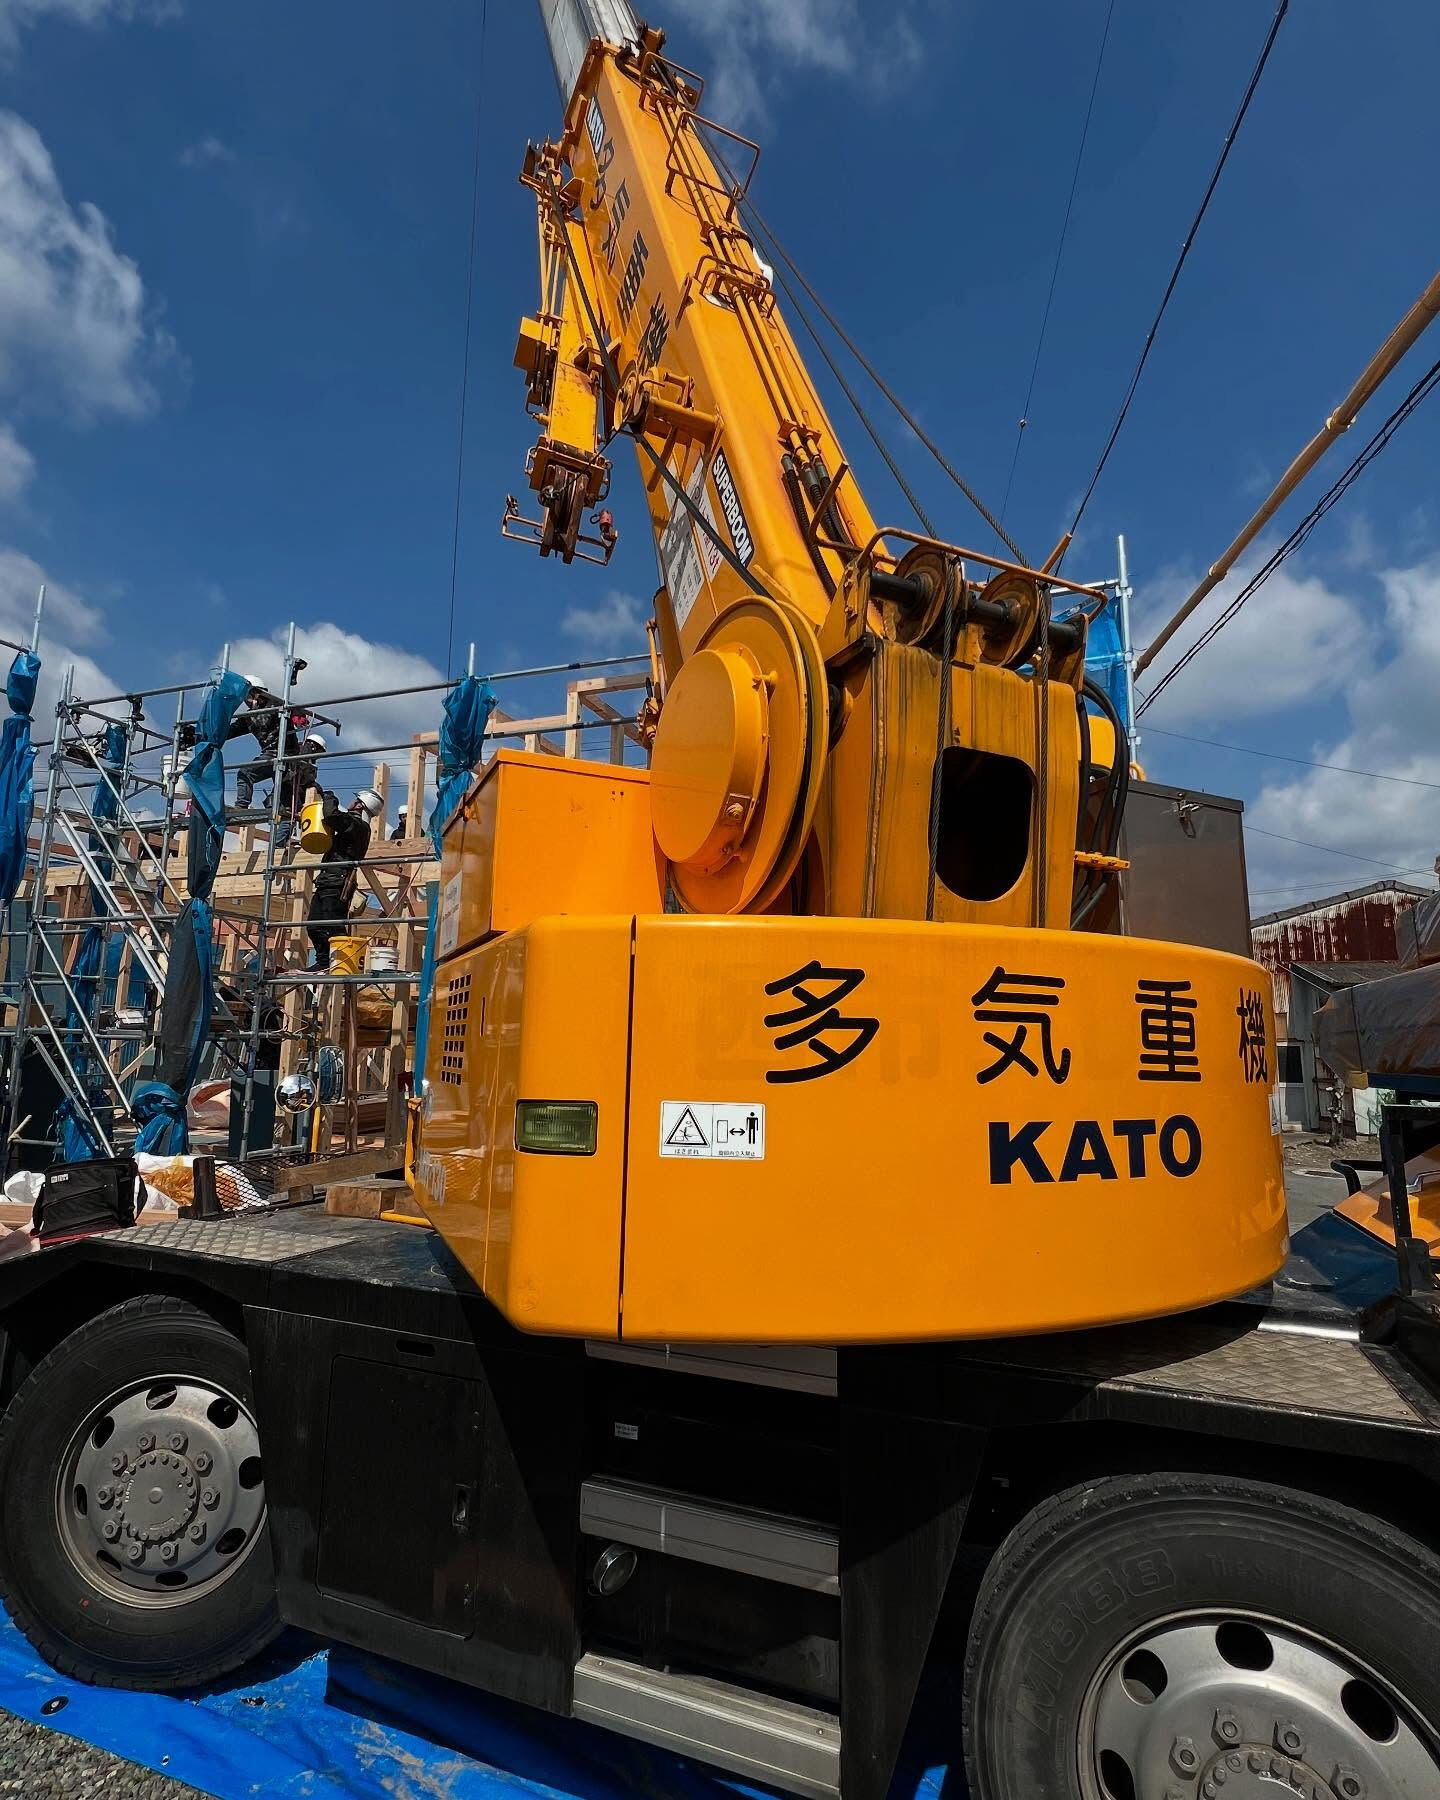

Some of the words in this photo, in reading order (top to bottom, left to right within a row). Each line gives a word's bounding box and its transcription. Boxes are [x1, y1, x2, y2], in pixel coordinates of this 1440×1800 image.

[713, 453, 753, 566] SUPERBOOM
[764, 960, 1268, 1085] 多気重機
[988, 1114, 1202, 1185] KATO
